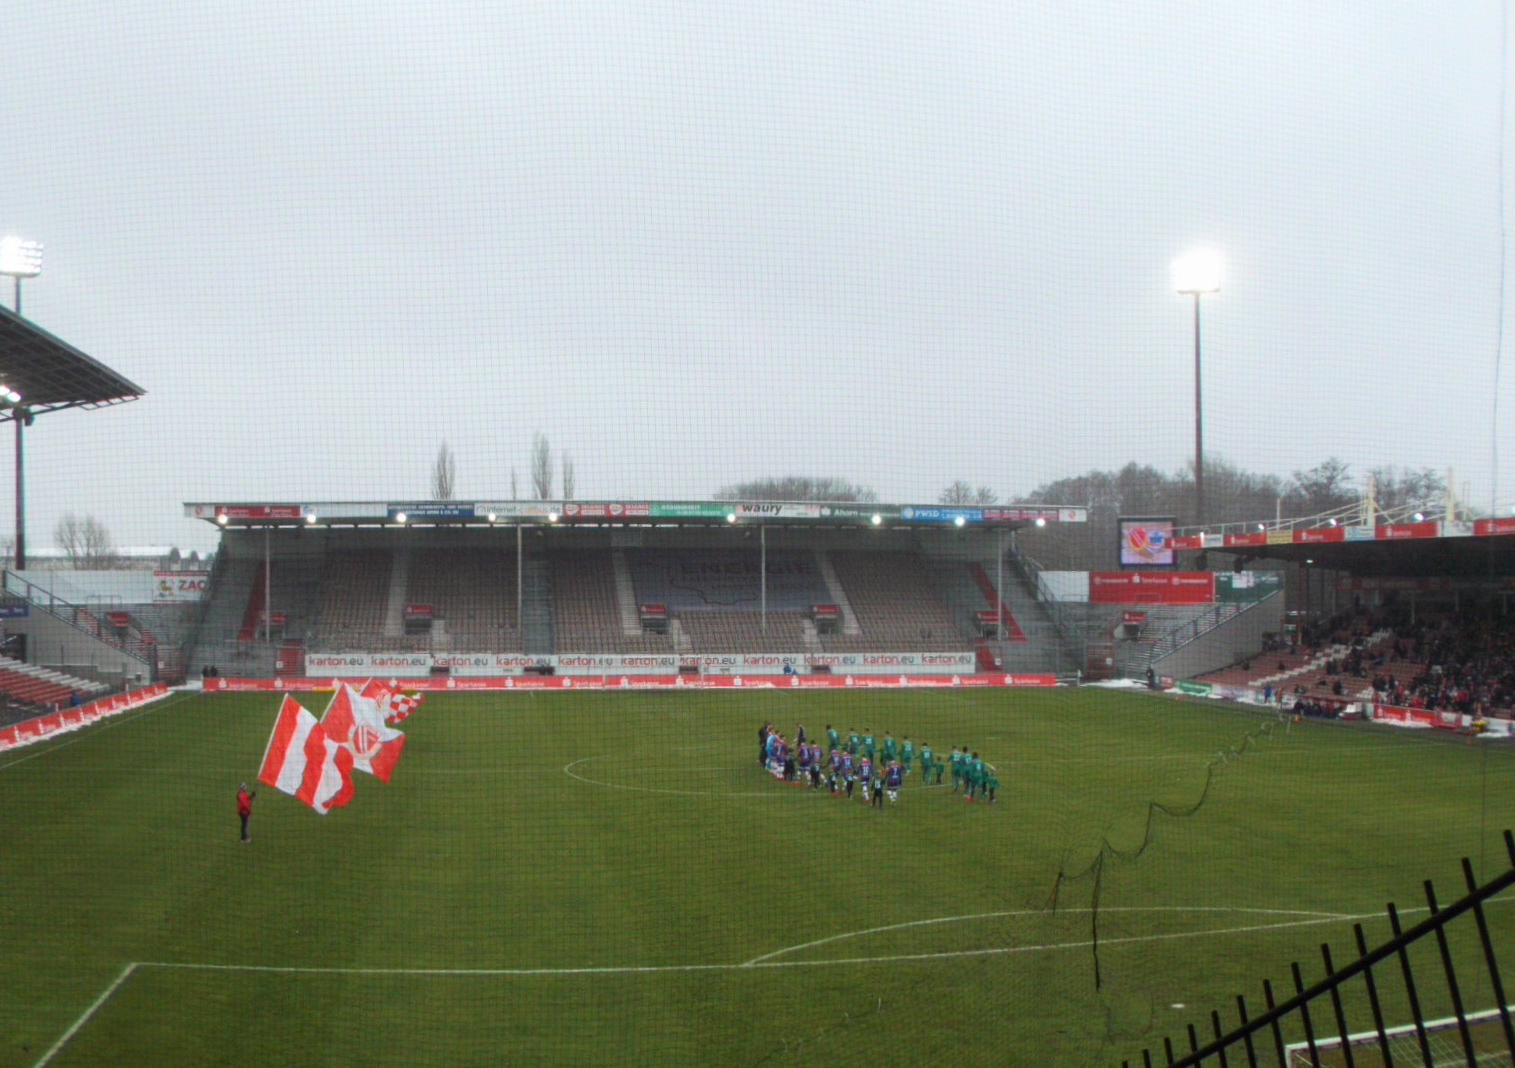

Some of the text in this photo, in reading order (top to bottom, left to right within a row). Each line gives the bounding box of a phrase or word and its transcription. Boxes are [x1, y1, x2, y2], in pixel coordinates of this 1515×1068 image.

[742, 504, 782, 516] waury
[834, 509, 858, 517] Ahorn
[309, 656, 364, 666] karton.eu
[371, 656, 426, 666] karton.eu
[434, 656, 489, 666] karton.eu
[621, 656, 675, 666] karton.eu
[681, 655, 736, 665] karon.eu
[743, 655, 797, 665] karton.eu
[804, 655, 856, 665] karton.eu
[863, 654, 915, 664] karton.eu
[921, 654, 972, 664] karton.eu
